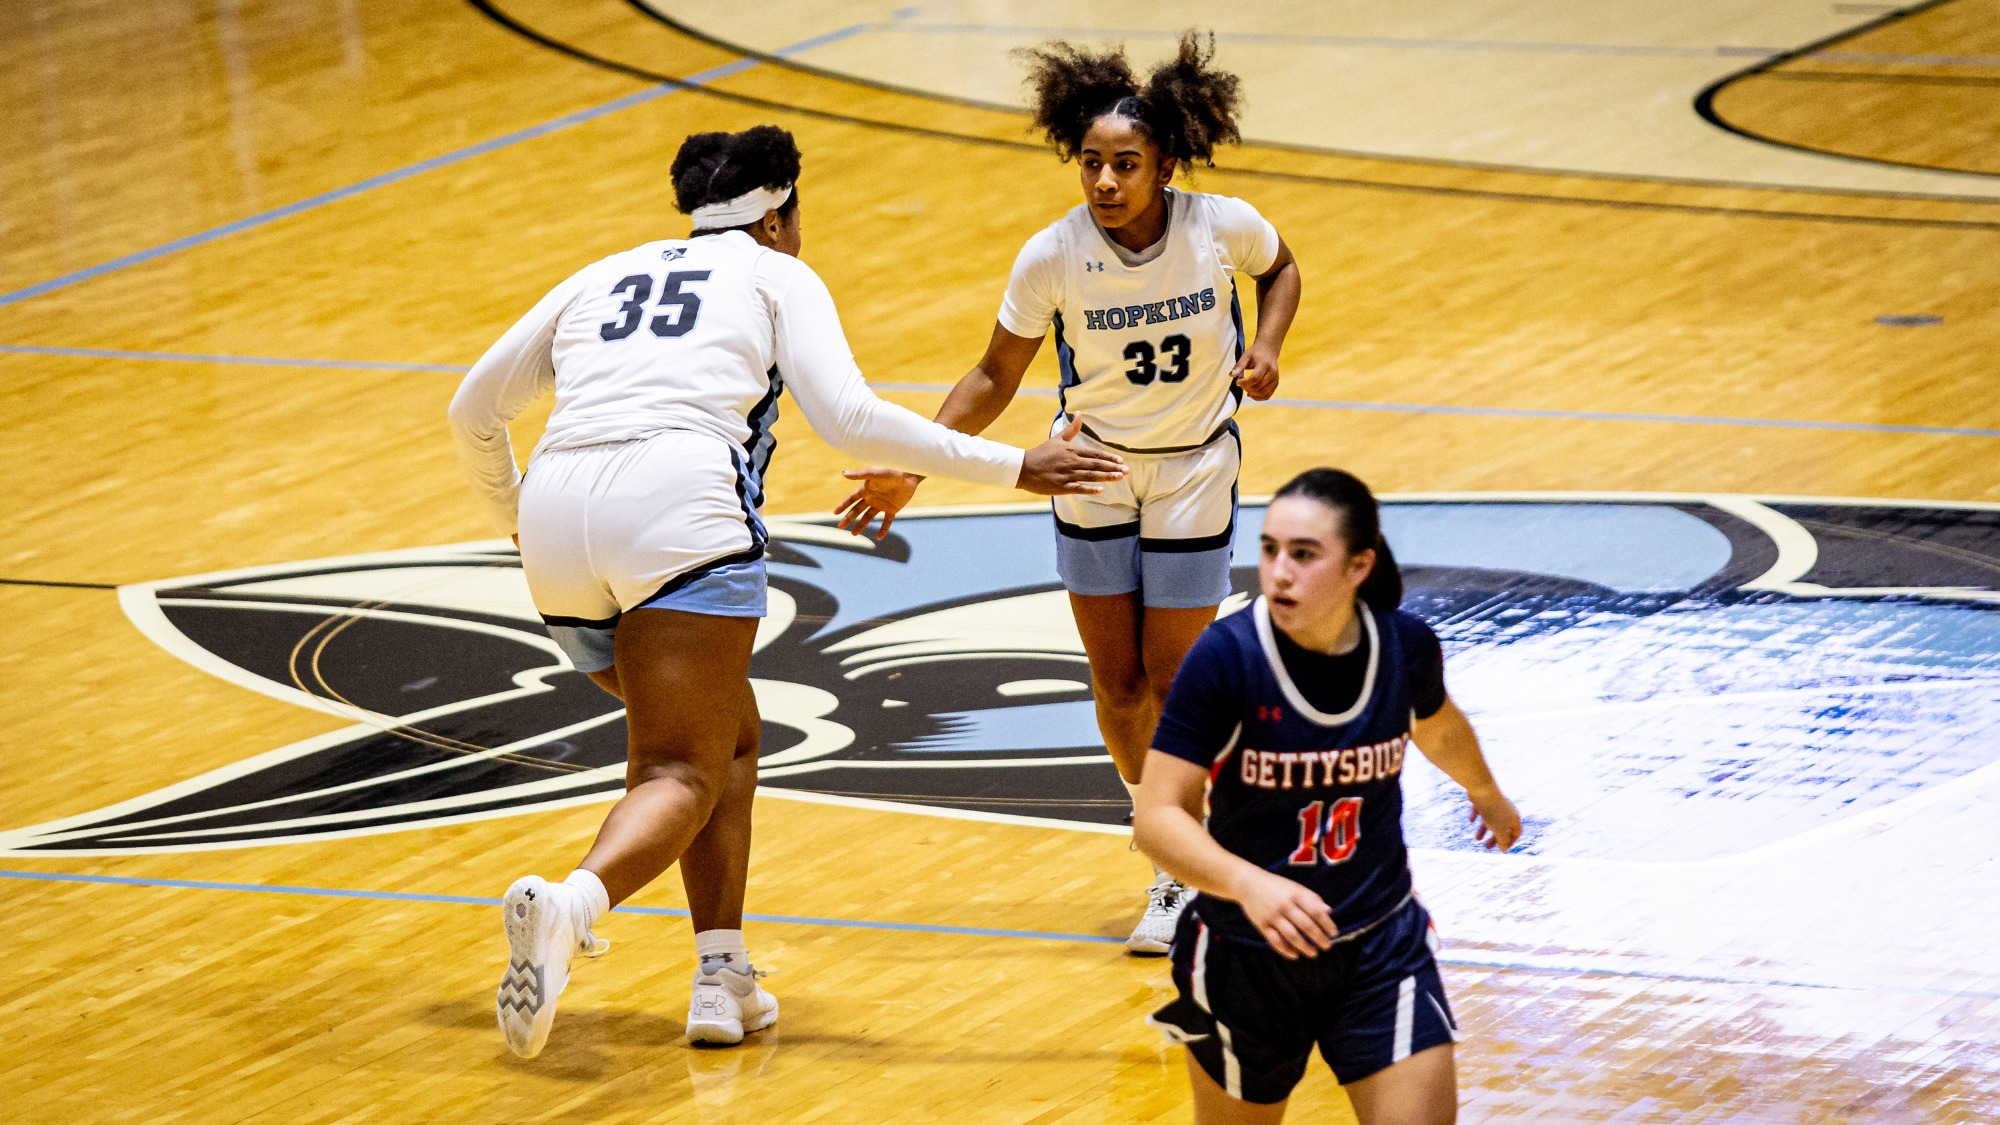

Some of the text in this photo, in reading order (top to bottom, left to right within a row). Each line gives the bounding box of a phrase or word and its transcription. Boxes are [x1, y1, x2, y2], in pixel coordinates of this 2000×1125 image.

[598, 269, 714, 343] 35
[1084, 287, 1216, 330] HOPKINS
[1122, 333, 1192, 386] 33
[1240, 732, 1410, 788] GETTYSBUR
[1288, 796, 1364, 866] 10
